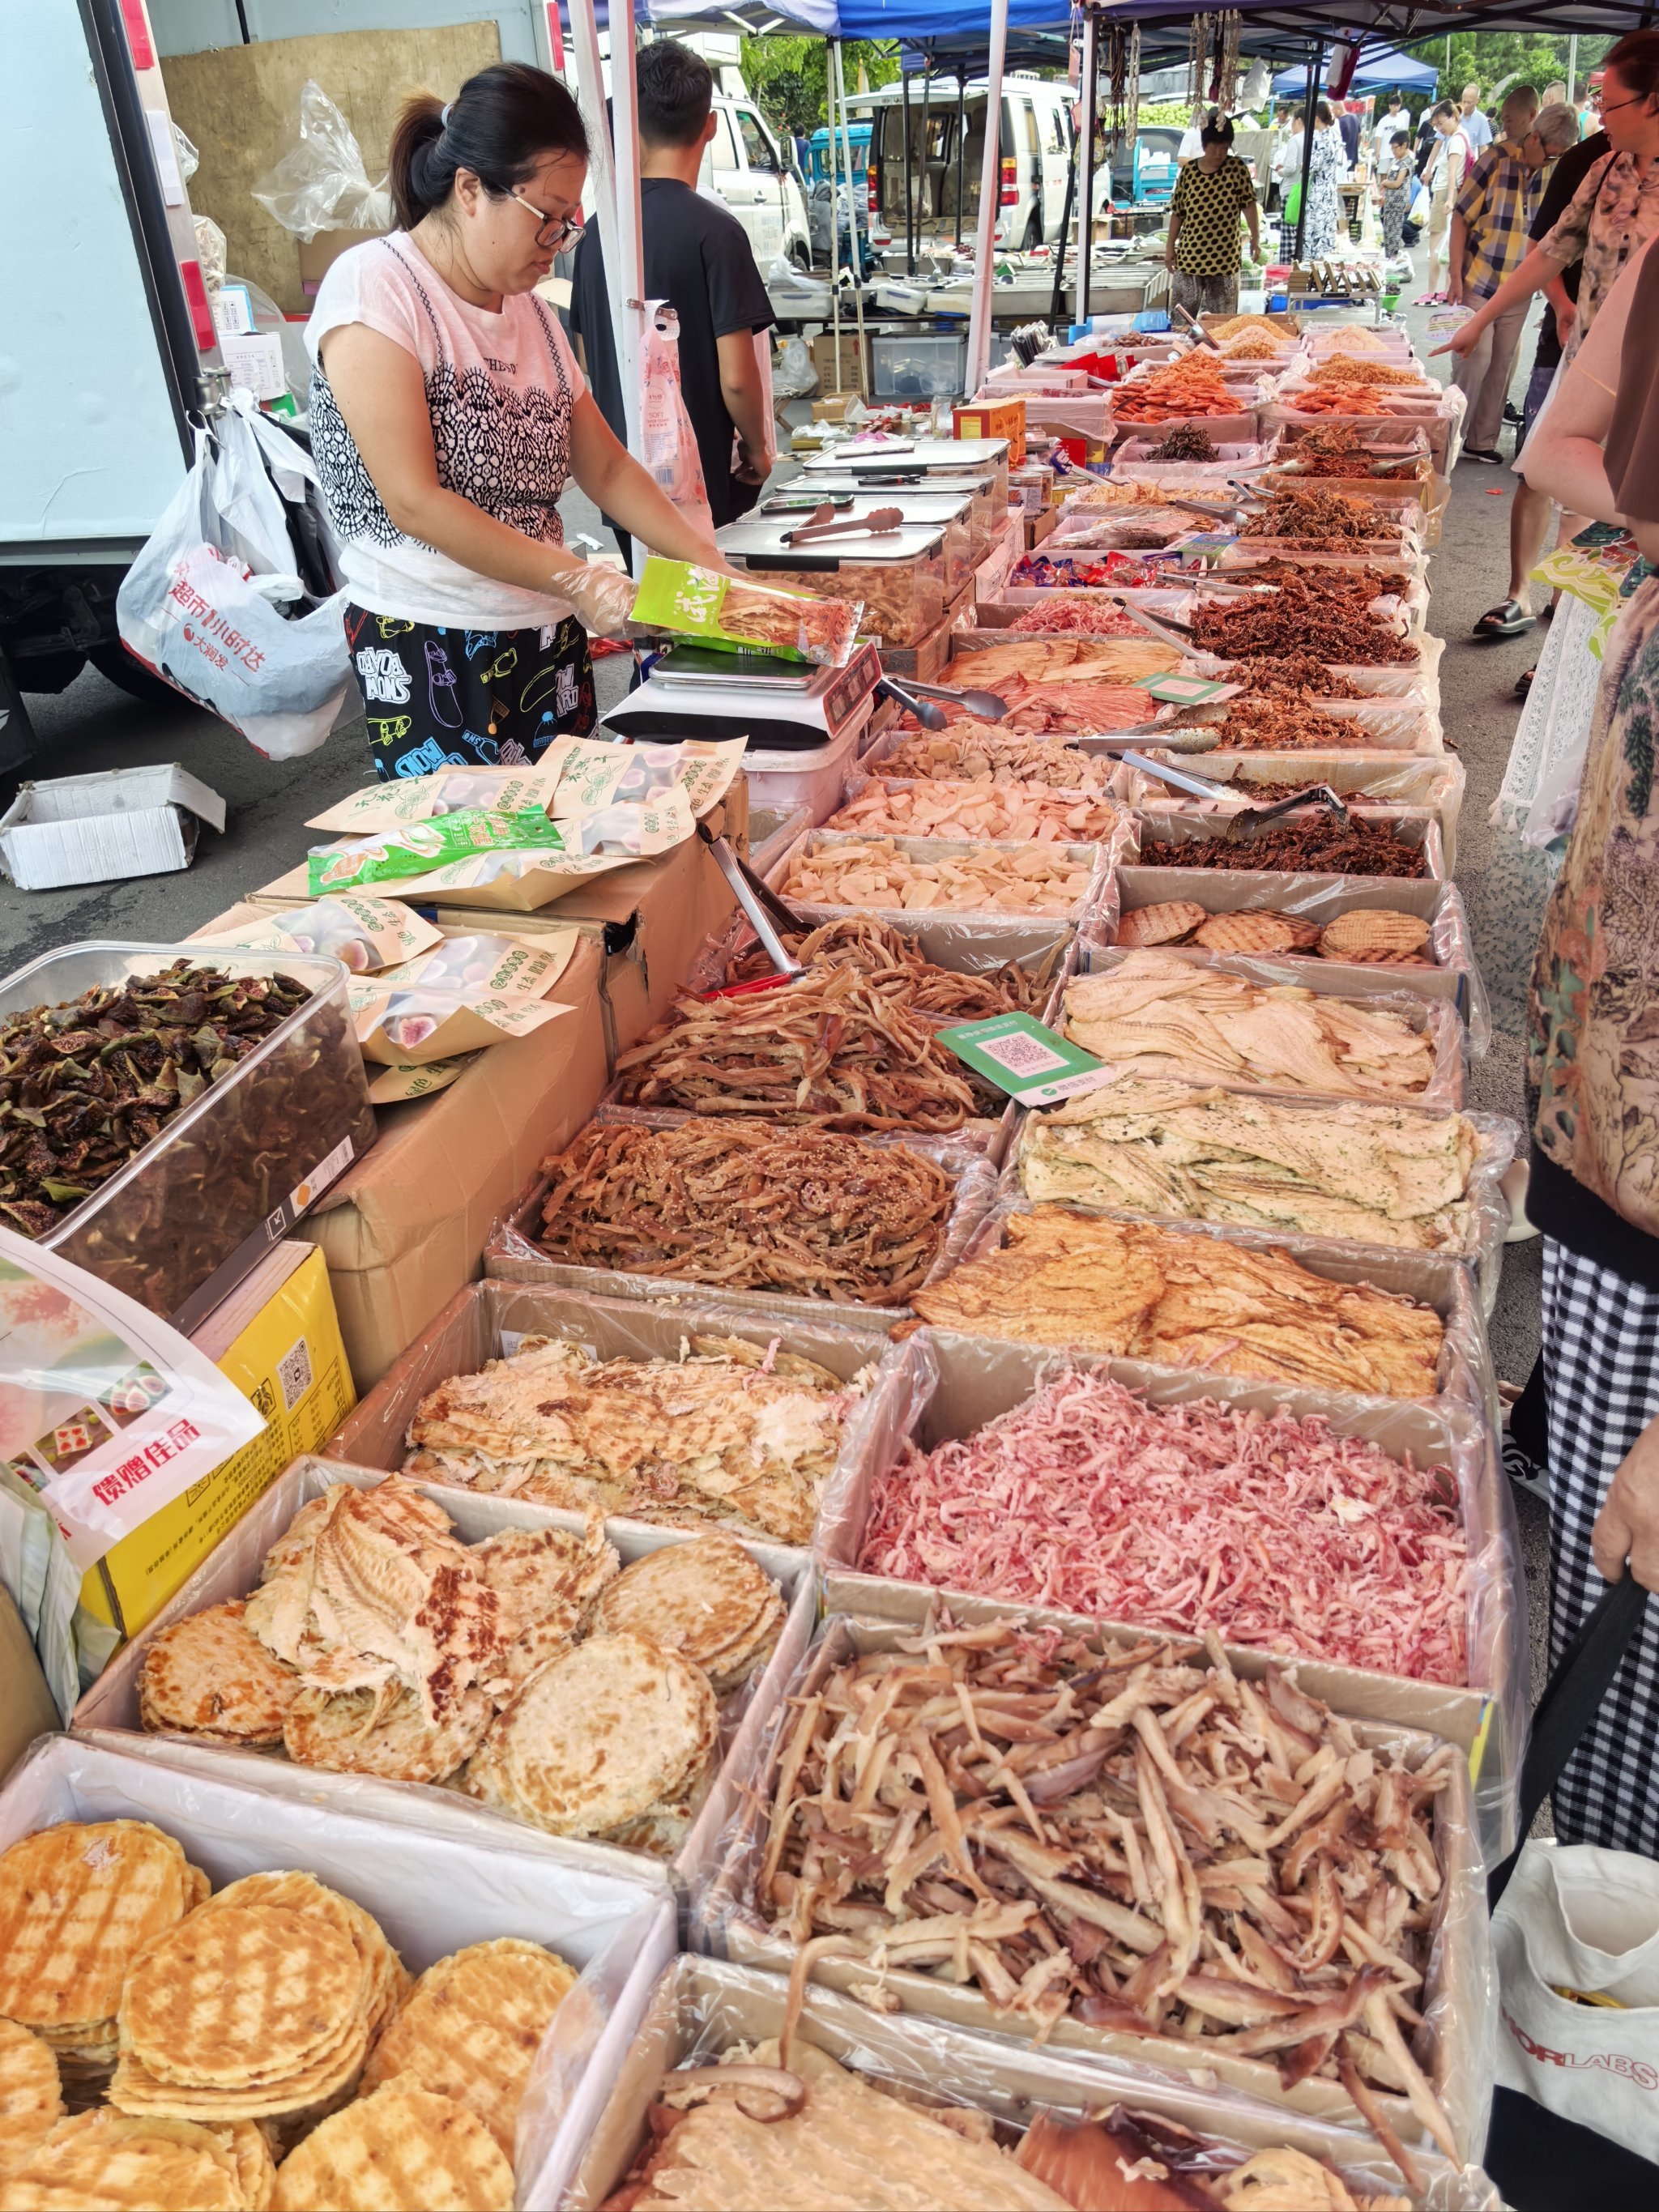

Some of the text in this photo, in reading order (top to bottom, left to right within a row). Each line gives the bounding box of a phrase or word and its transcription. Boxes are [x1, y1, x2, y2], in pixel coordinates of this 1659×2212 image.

[168, 578, 266, 672] 超市1小时达
[194, 636, 228, 671] 大润发
[356, 647, 406, 678] BOARD
[366, 673, 412, 704] SNOW
[395, 737, 446, 778] SNOW
[516, 975, 538, 991] 生态
[405, 1078, 433, 1097] 绿色
[1056, 1076, 1098, 1092] 微信支付
[92, 1419, 201, 1506] 馈赠佳品
